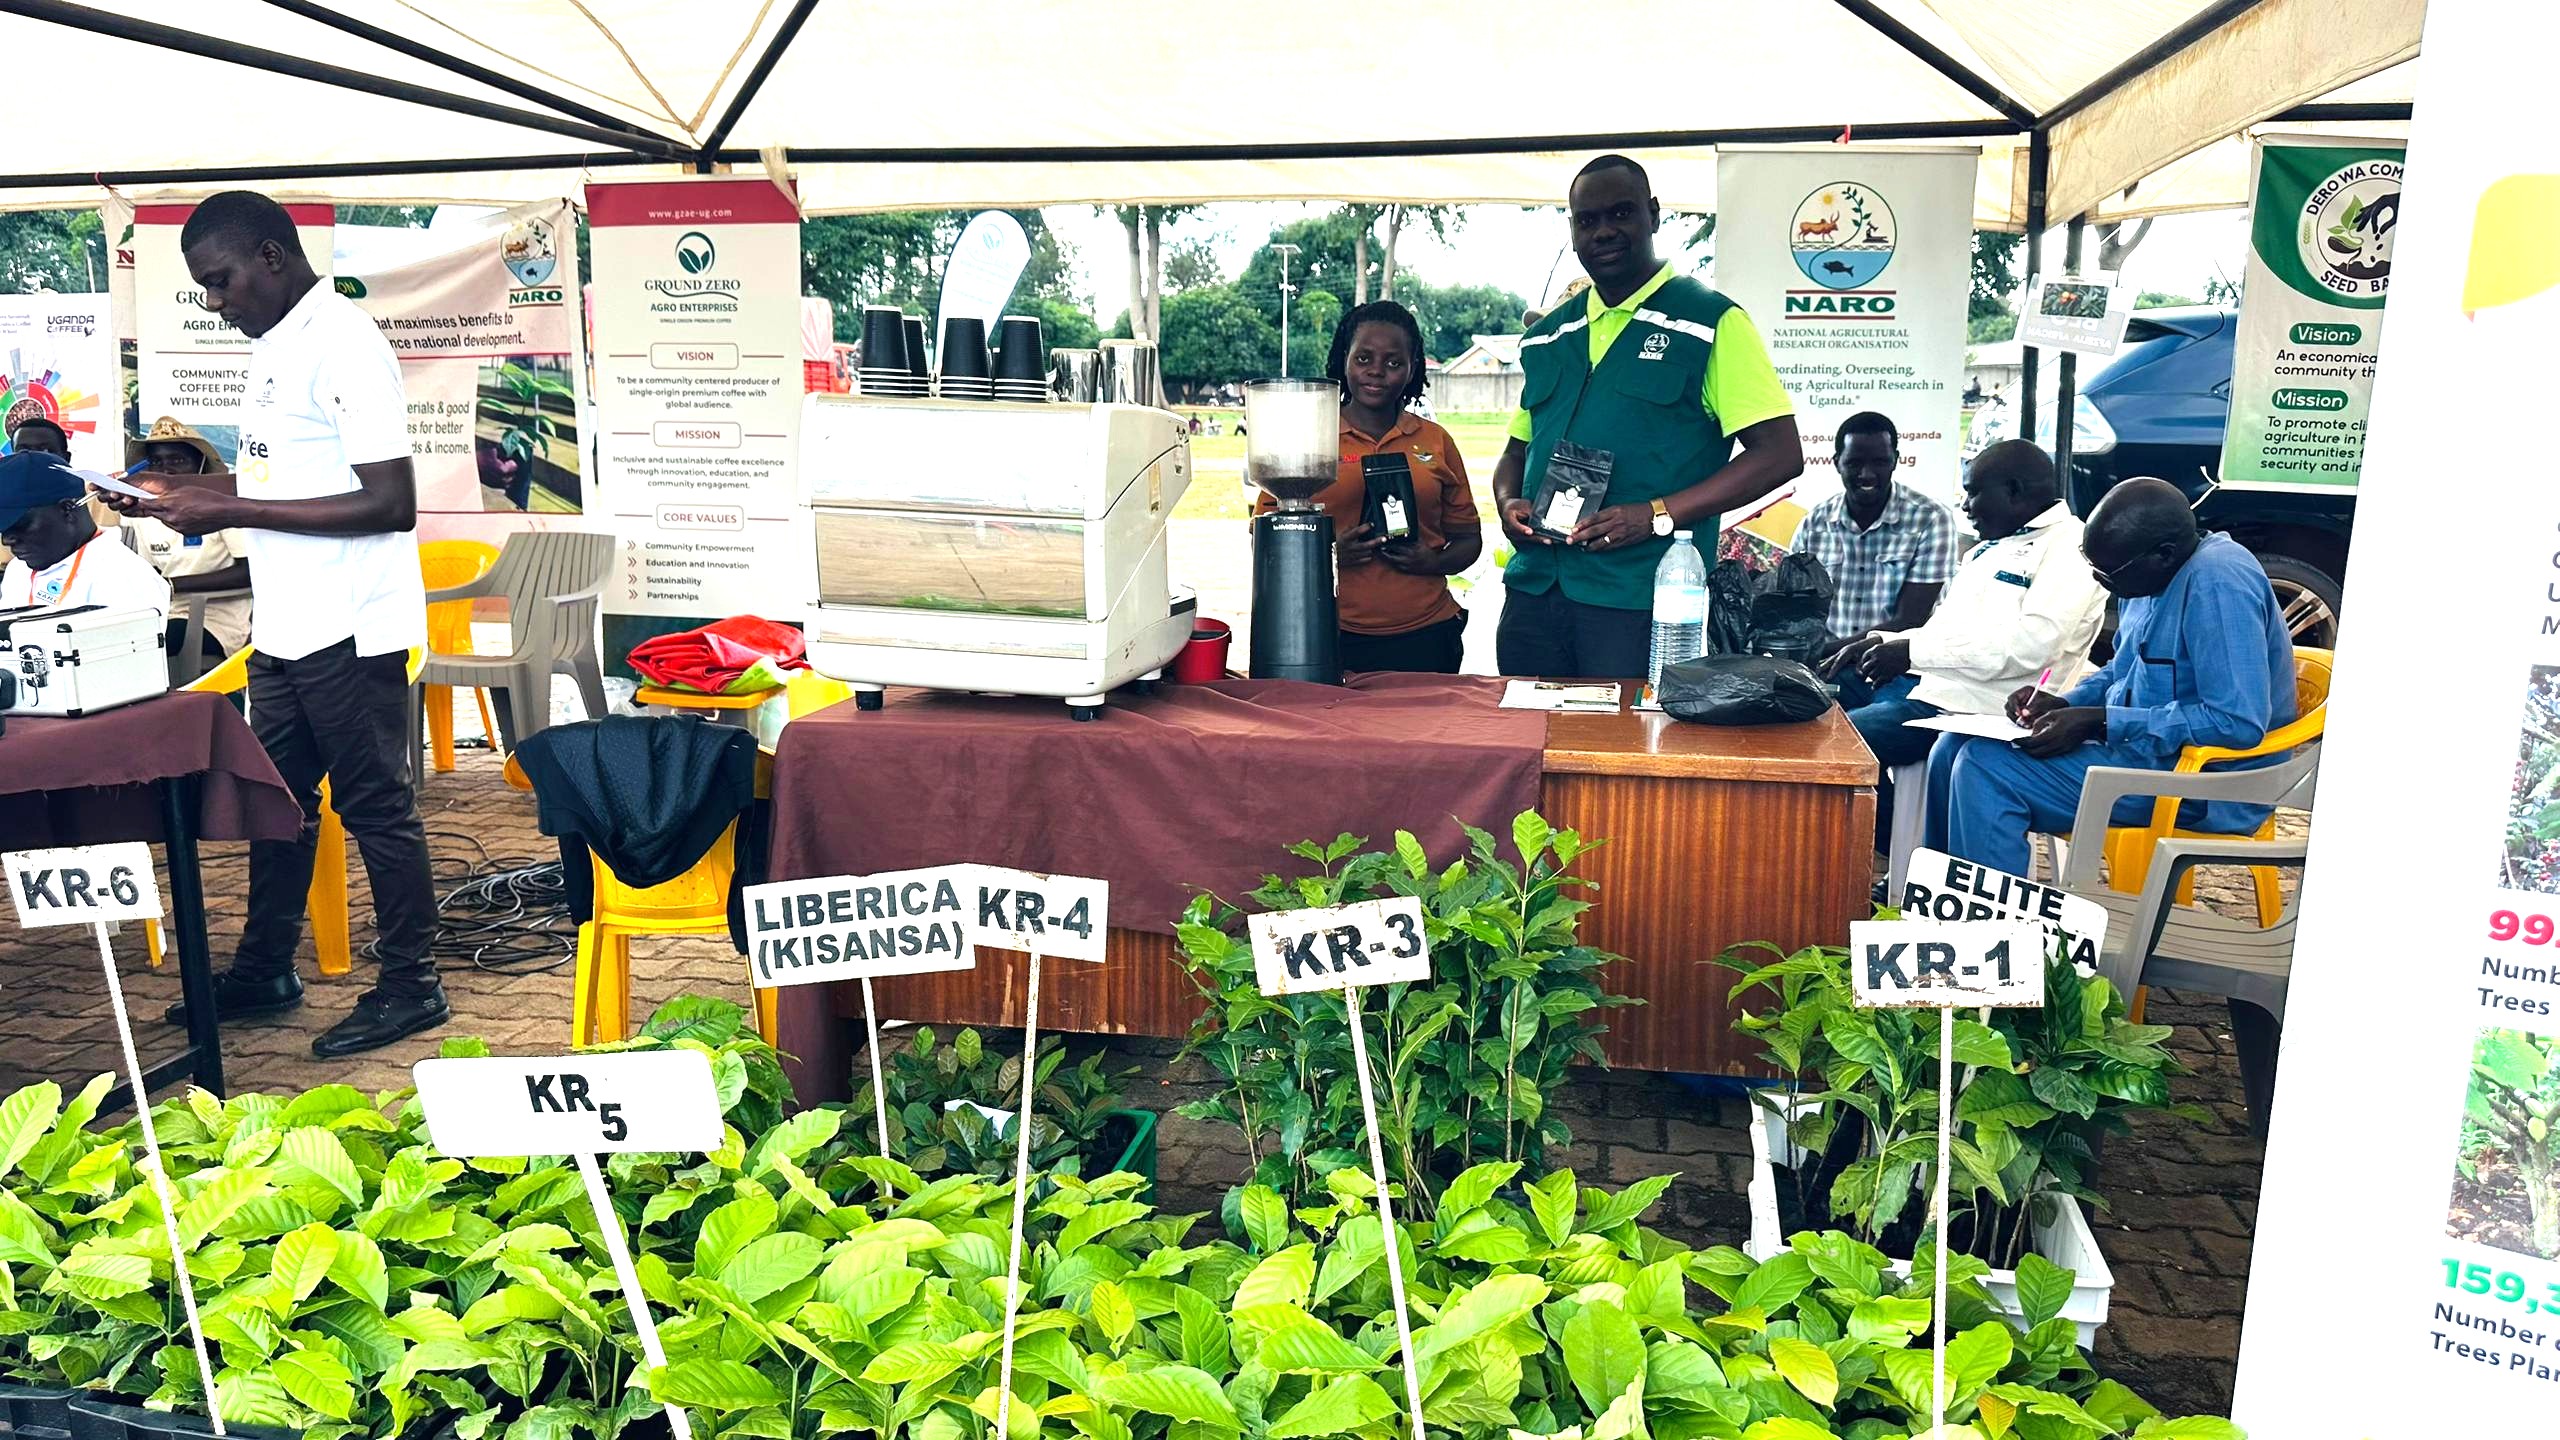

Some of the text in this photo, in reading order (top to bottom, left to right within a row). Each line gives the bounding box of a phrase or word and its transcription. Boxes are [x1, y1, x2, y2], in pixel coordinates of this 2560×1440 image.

[2306, 180, 2339, 215] DERO
[2338, 166, 2366, 183] WA
[648, 209, 732, 219] www.gzae-ug.com
[644, 279, 741, 292] GROUND ZERO
[2320, 270, 2358, 293] SEED
[509, 290, 563, 304] NARO
[650, 303, 738, 312] AGRO ENTERPRISES
[1785, 296, 1895, 313] NARO
[47, 315, 95, 325] UGANDA
[183, 320, 215, 331] AGRO
[394, 316, 457, 330] maximises
[459, 312, 502, 328] benefits
[504, 313, 513, 325] to
[1773, 328, 1910, 337] NATIONAL AGRICULTURAL
[2297, 326, 2355, 342] Vision:
[413, 334, 461, 349] national
[464, 332, 525, 349] development.
[1773, 340, 1909, 349] RESEARCH ORGANISATION
[677, 352, 714, 361] VISION
[2276, 349, 2295, 361] An
[1845, 364, 1915, 377] Overseeing,
[2274, 366, 2356, 380] community
[179, 383, 246, 393] COFFEE PRO
[645, 377, 692, 386] community
[695, 377, 730, 385] centered
[732, 378, 769, 387] producer
[771, 377, 780, 385] of
[1806, 379, 1874, 393] Agricultural
[1878, 379, 1929, 390] Research
[1932, 380, 1944, 390] in
[629, 389, 680, 397] single-origin
[682, 389, 720, 398] premium
[721, 389, 746, 397] coffee
[2276, 391, 2343, 408] Mission
[170, 397, 199, 406] WITH
[665, 401, 692, 410] global
[437, 401, 444, 414] &
[446, 401, 470, 417] good
[419, 422, 432, 434] for
[435, 422, 464, 434] better
[2267, 416, 2281, 427] To
[2285, 419, 2347, 430] promote
[675, 430, 721, 440] MISSION
[2264, 432, 2340, 444] agriculture
[2344, 434, 2356, 444] in
[425, 443, 432, 454] &
[435, 443, 471, 454] income.
[2262, 446, 2355, 459] communities
[613, 456, 646, 464] Inclusive
[665, 457, 713, 465] sustainable
[714, 458, 740, 466] coffee
[741, 458, 785, 466] excellence
[2260, 460, 2317, 474] security
[2321, 461, 2349, 472] and
[627, 467, 769, 478] through innovation, education, and
[647, 480, 751, 490] community engagement.
[664, 513, 737, 523] CORE VALUES
[645, 542, 754, 553] Community Empowerment
[646, 559, 749, 570] Education and Innovation
[646, 575, 702, 587] Sustainability
[647, 591, 699, 602] Partnerships
[19, 865, 139, 910] KR-6
[1945, 858, 2066, 922] ELITE
[754, 878, 962, 932] LIBERICA
[978, 886, 1093, 940] KR-4
[1901, 881, 2098, 970] ROBTA
[758, 921, 964, 980] (KISANSA)
[1276, 913, 1422, 979] KR-3
[1866, 940, 2014, 990] KR-1
[2477, 987, 2550, 1015] Trees
[2434, 1302, 2547, 1346] Number
[2430, 1330, 2501, 1366] Trees
